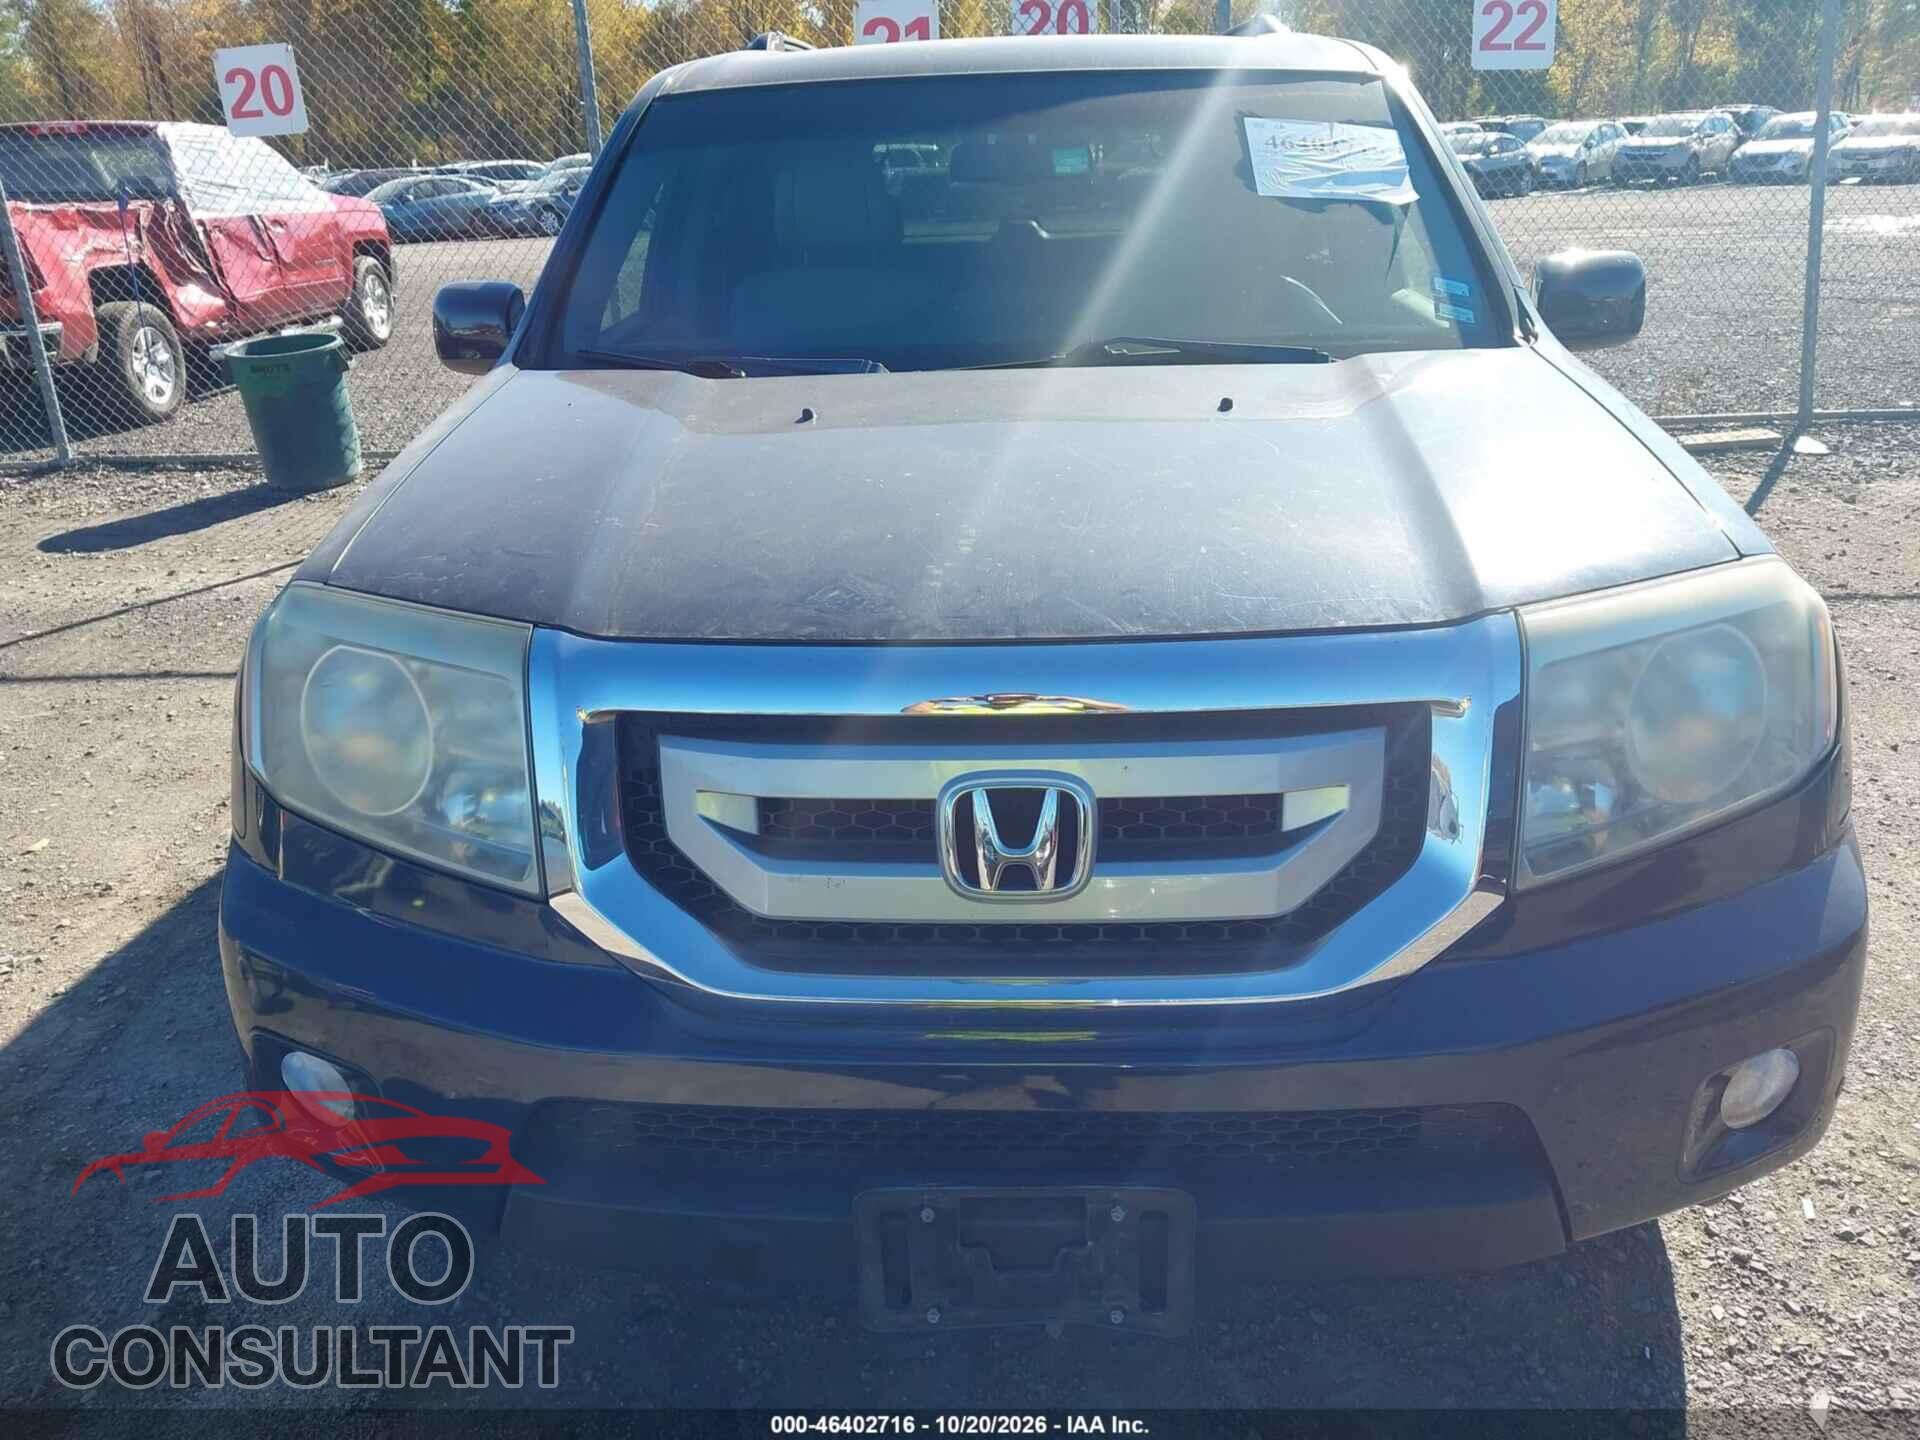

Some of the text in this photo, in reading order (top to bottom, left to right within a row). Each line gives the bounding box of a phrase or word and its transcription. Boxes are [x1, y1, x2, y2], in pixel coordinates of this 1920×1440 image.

[1019, 0, 1089, 35] 20
[1480, 0, 1548, 50] 22
[225, 65, 294, 119] 20
